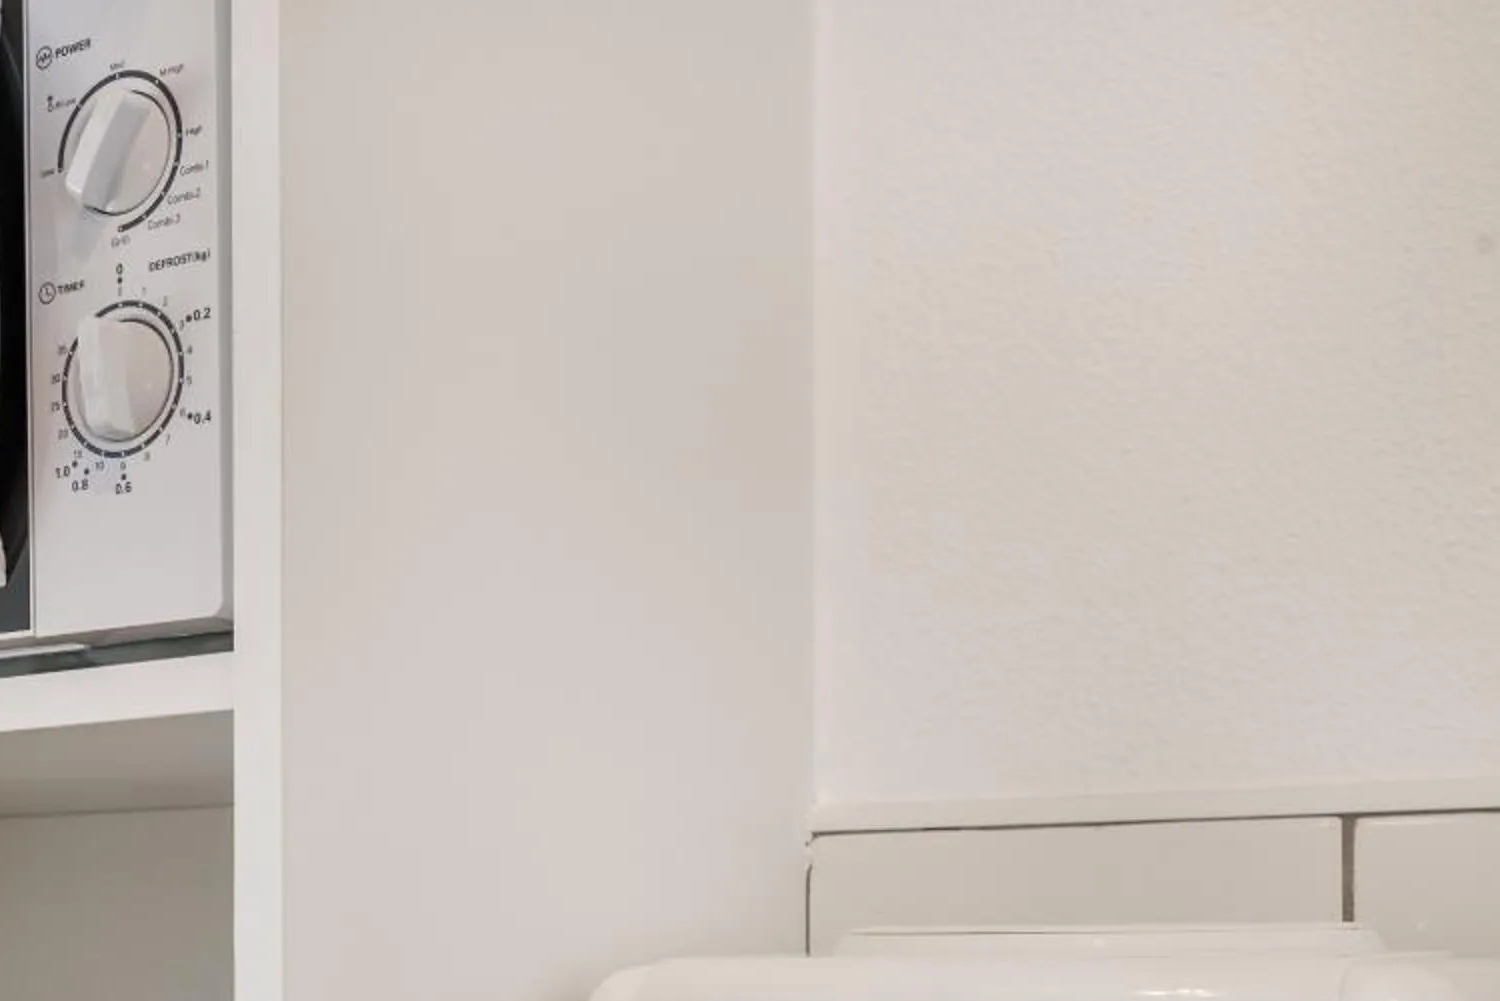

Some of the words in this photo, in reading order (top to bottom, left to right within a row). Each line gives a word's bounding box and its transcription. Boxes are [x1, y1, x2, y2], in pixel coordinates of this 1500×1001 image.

[55, 37, 91, 59] POWER
[115, 263, 124, 275] 0
[193, 307, 211, 321] 0.2
[194, 409, 211, 424] 0.4
[71, 478, 89, 493] 0.8
[115, 481, 133, 495] 0.6
